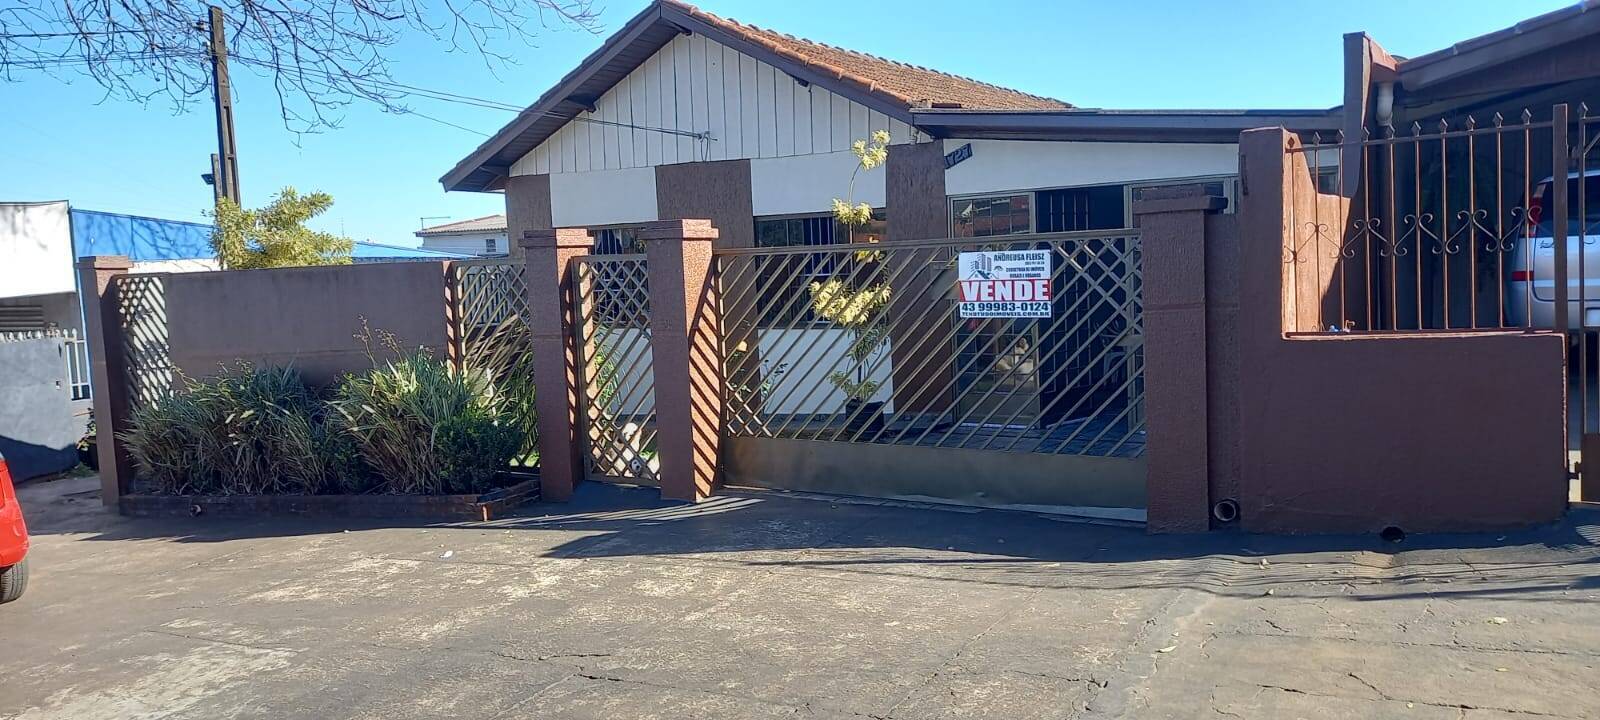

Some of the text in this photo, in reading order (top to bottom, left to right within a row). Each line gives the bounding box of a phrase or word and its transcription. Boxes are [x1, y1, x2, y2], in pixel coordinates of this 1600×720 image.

[961, 280, 1049, 301] VENDE
[962, 303, 1048, 311] 43 99983-0124
